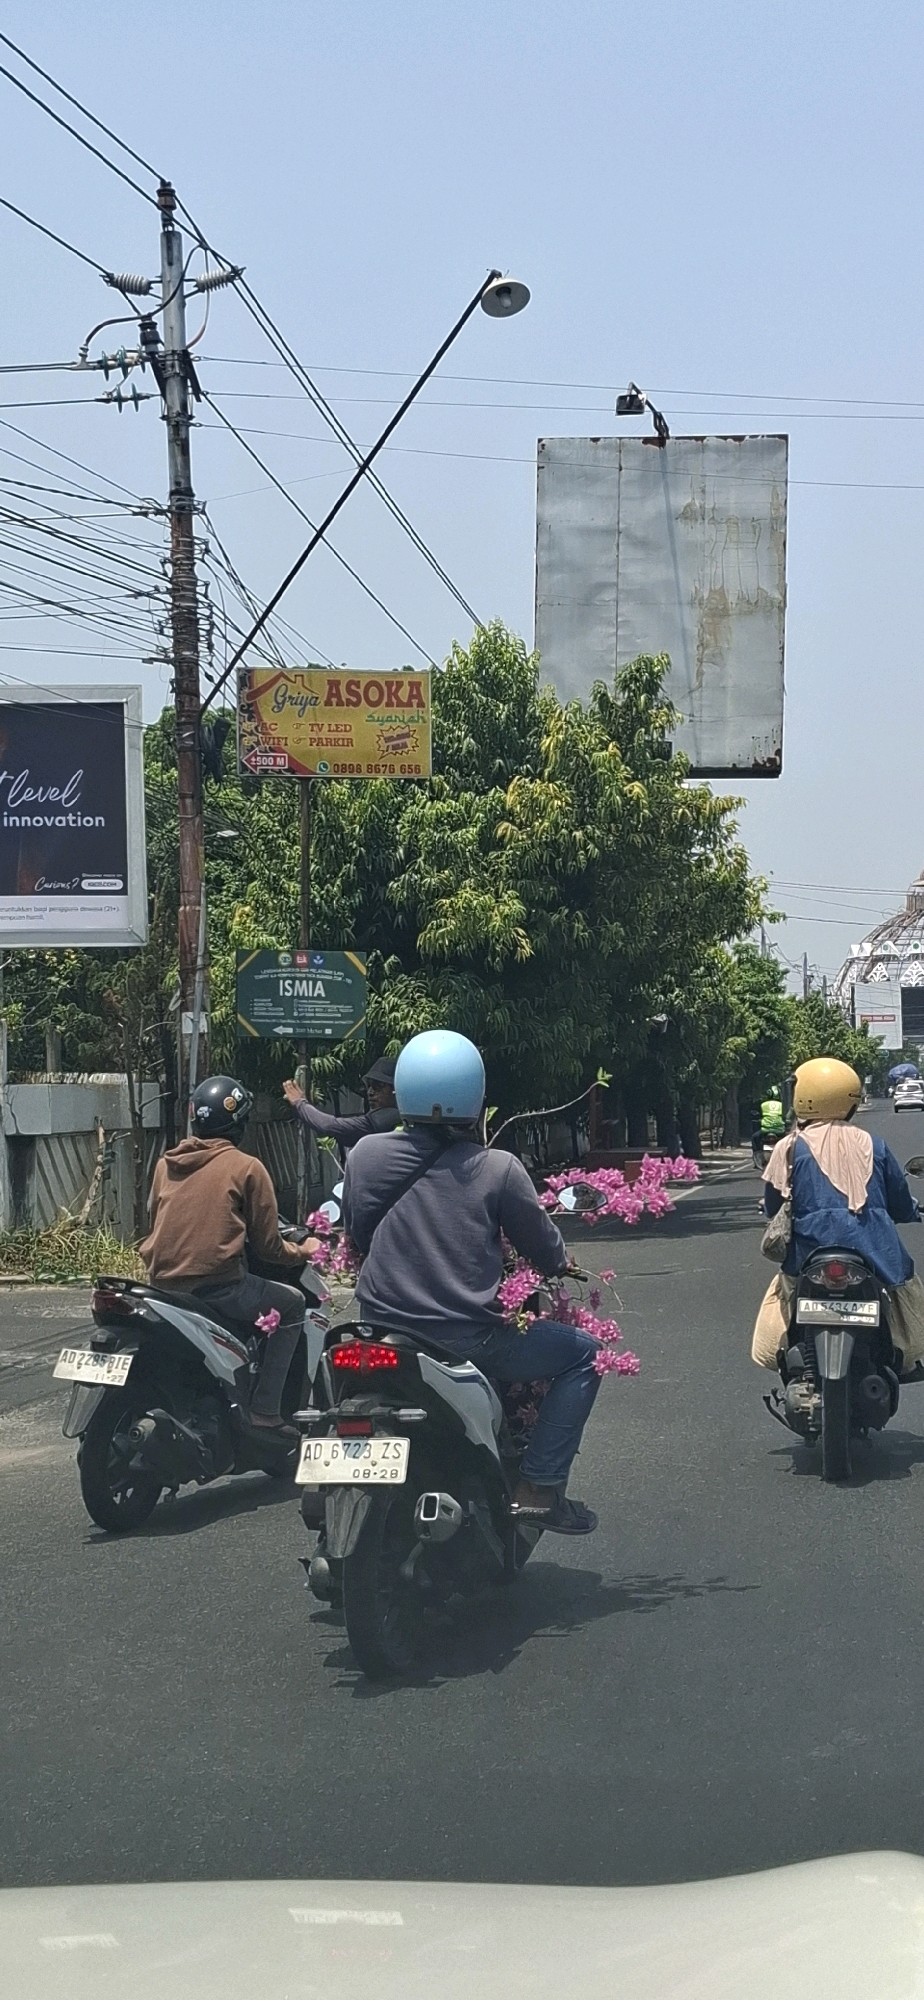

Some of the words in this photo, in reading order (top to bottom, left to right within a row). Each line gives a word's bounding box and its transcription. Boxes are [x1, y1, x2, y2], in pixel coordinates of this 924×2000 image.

[271, 683, 321, 718] Griya
[324, 679, 426, 708] ASOKA
[365, 710, 427, 727] Syariah
[260, 722, 278, 732] AC
[309, 723, 327, 733] TV
[328, 723, 353, 733] LED
[260, 736, 289, 747] WIFI
[309, 737, 354, 748] PARKIR
[276, 756, 285, 767] M
[366, 764, 396, 776] 8676
[399, 765, 422, 777] 656
[7, 769, 84, 808] level
[3, 811, 106, 828] innovation
[279, 979, 326, 998] ISMIA
[59, 1349, 77, 1364] AD
[77, 1352, 108, 1368] 2285
[107, 1356, 131, 1371] BIE
[303, 1442, 323, 1462] AD
[331, 1442, 372, 1460] 6723
[381, 1442, 403, 1460] ZS
